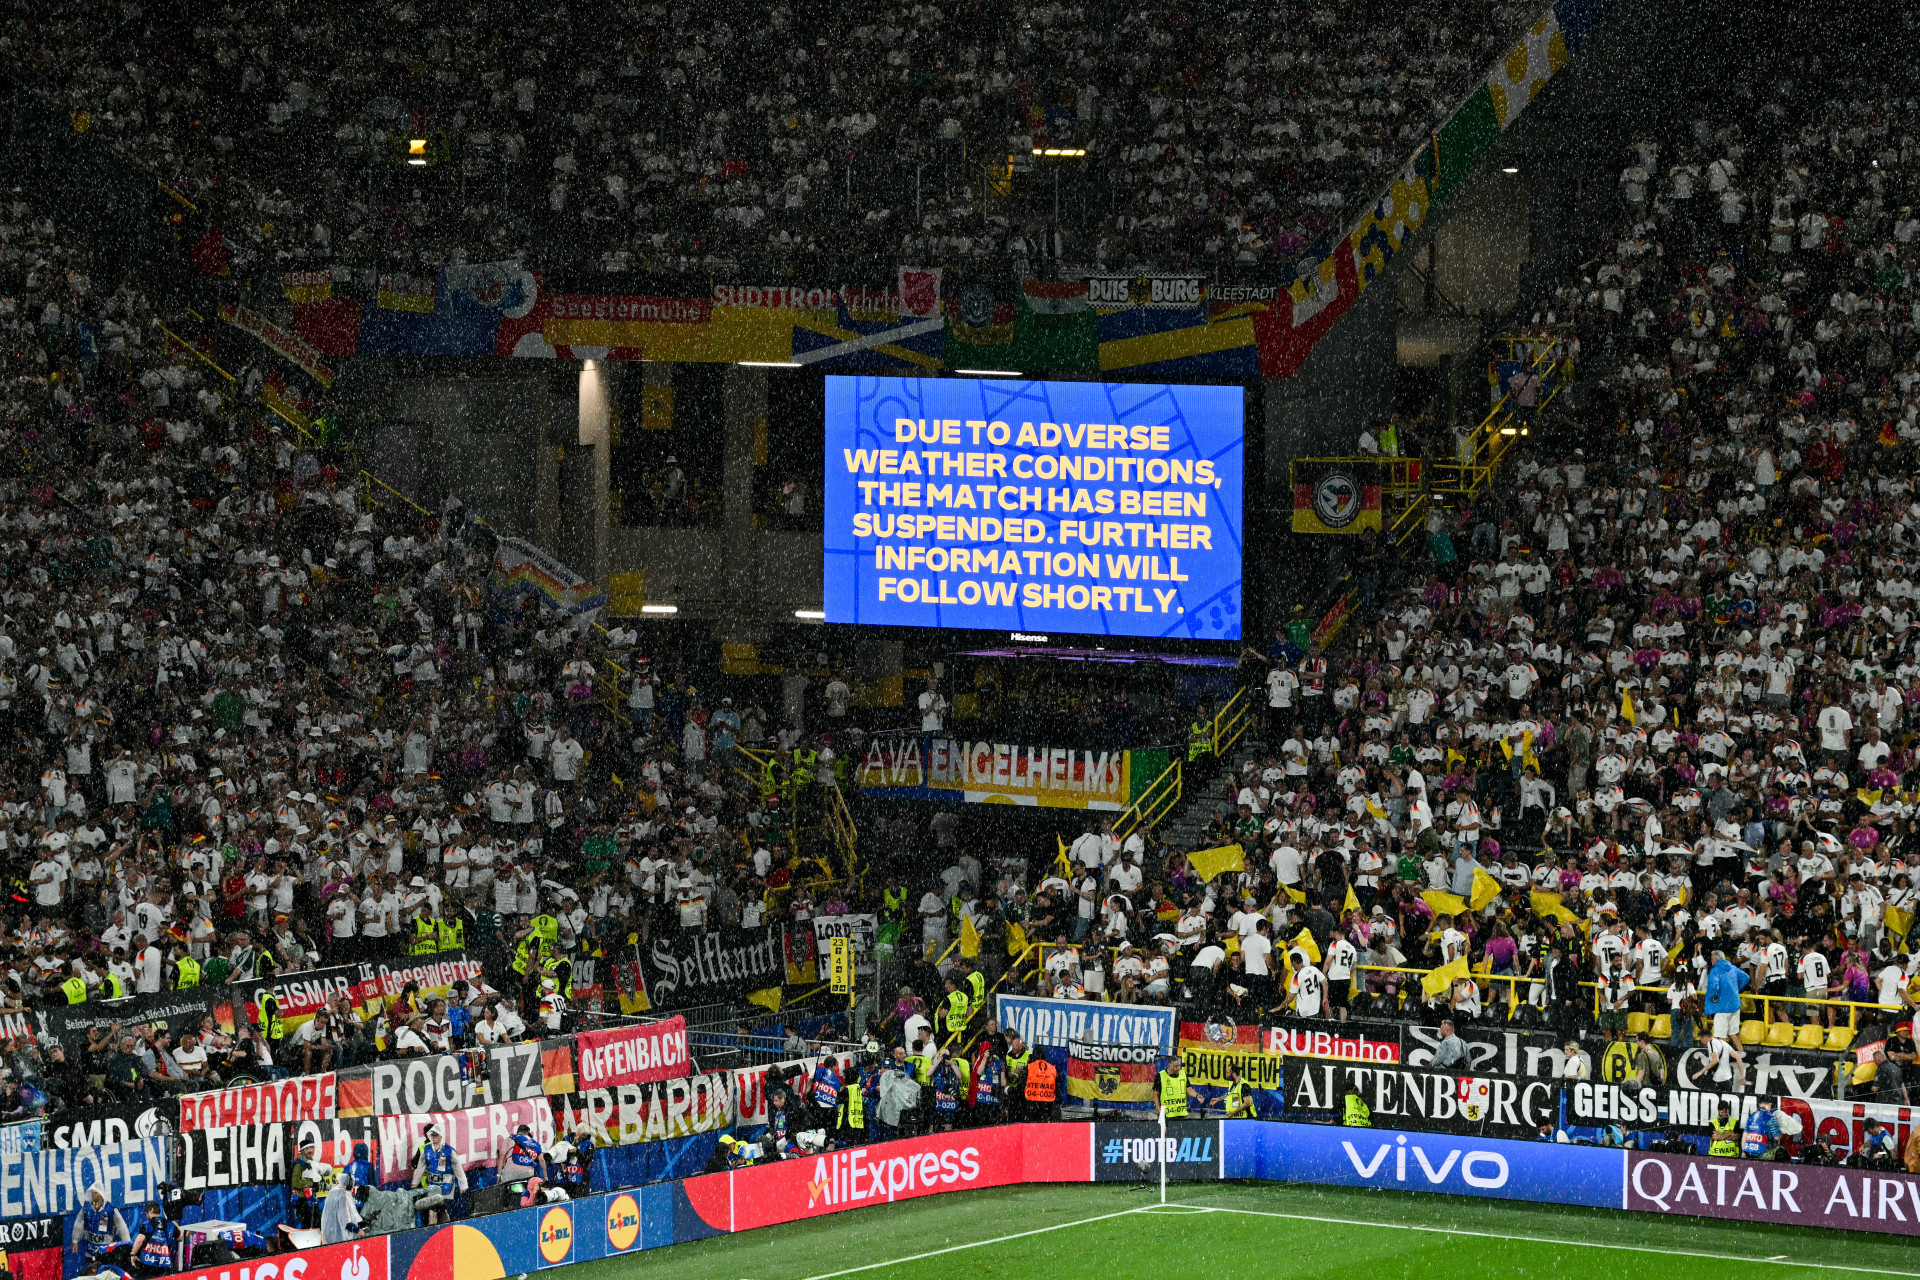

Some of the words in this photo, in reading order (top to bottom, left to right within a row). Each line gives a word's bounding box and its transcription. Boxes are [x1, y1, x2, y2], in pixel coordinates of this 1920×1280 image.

[896, 419, 960, 444] DUE
[968, 421, 1010, 445] TO
[1016, 422, 1169, 450] ADVERSE
[844, 449, 1007, 477] WEATHER
[1010, 454, 1222, 492] CONDITIONS,
[858, 481, 921, 506] THE
[927, 483, 1041, 511] MATCH
[1048, 488, 1114, 513] HAS
[1120, 490, 1206, 517] BEEN
[853, 513, 1053, 546] SUSPENDED.
[1060, 520, 1212, 549] FURTHER
[876, 544, 1099, 580] INFORMATION
[1105, 554, 1188, 581] WILL
[879, 577, 1018, 606] FOLLOW
[1023, 583, 1184, 614] SHORTLY.
[1011, 633, 1048, 642] Hisense
[931, 739, 1123, 795] ENGELHELMS
[832, 939, 844, 947] 23
[835, 957, 842, 965] 4
[1340, 949, 1354, 969] 24
[1773, 951, 1785, 970] 17
[835, 975, 842, 984] 3
[1304, 973, 1320, 995] 24
[1814, 961, 1824, 978] 8
[554, 997, 564, 1013] 10
[1004, 1006, 1166, 1056] NORDHAUSEN
[1270, 1026, 1393, 1064] RUBinho
[582, 1029, 687, 1082] OFFENBACH
[1068, 1040, 1158, 1063] WIESMOOR
[54, 1118, 130, 1149] SMD
[1102, 1137, 1213, 1163] #FOOTBALL
[182, 1122, 286, 1191] LEIHA
[1342, 1134, 1509, 1189] vivo
[0, 1135, 166, 1217] ENHOFEN
[808, 1147, 980, 1209] AliExpress
[1632, 1158, 1802, 1212] QATAR
